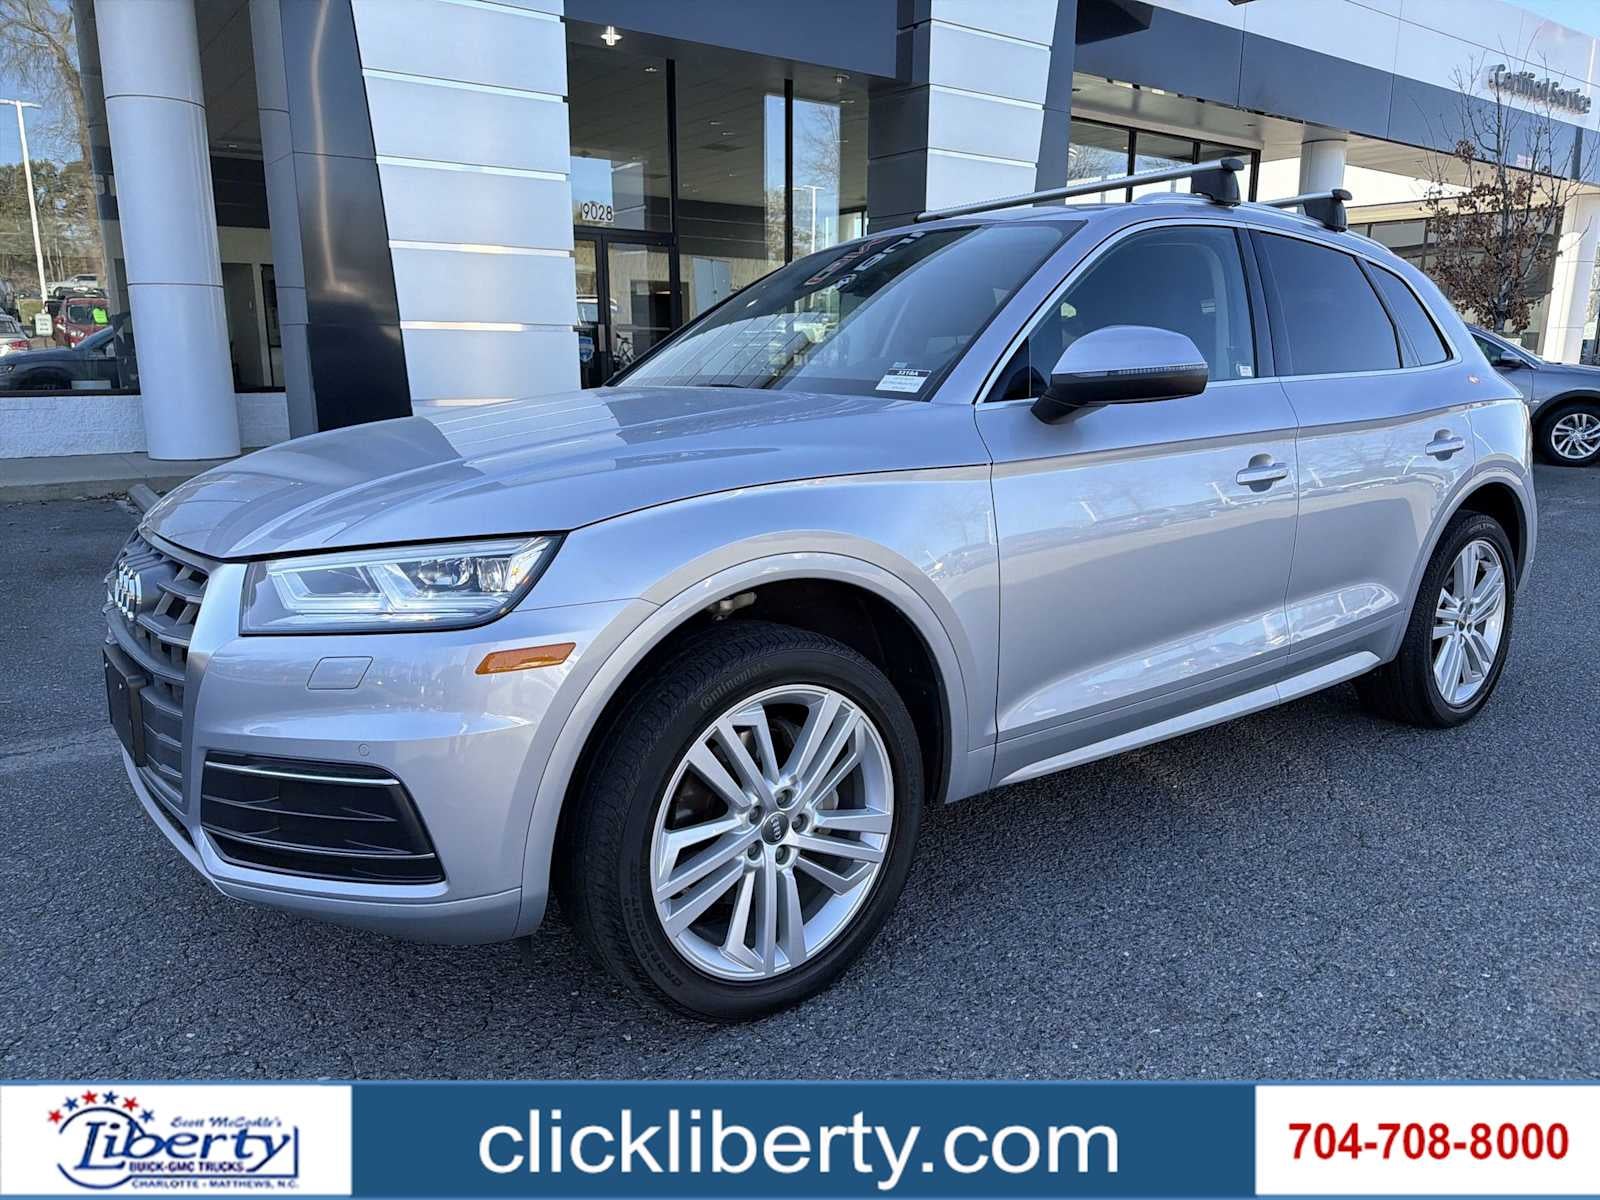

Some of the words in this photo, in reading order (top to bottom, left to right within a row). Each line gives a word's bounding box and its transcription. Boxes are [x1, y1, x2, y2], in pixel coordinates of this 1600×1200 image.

[1488, 64, 1550, 101] Certified
[1549, 81, 1592, 114] Service
[582, 202, 613, 221] 9028
